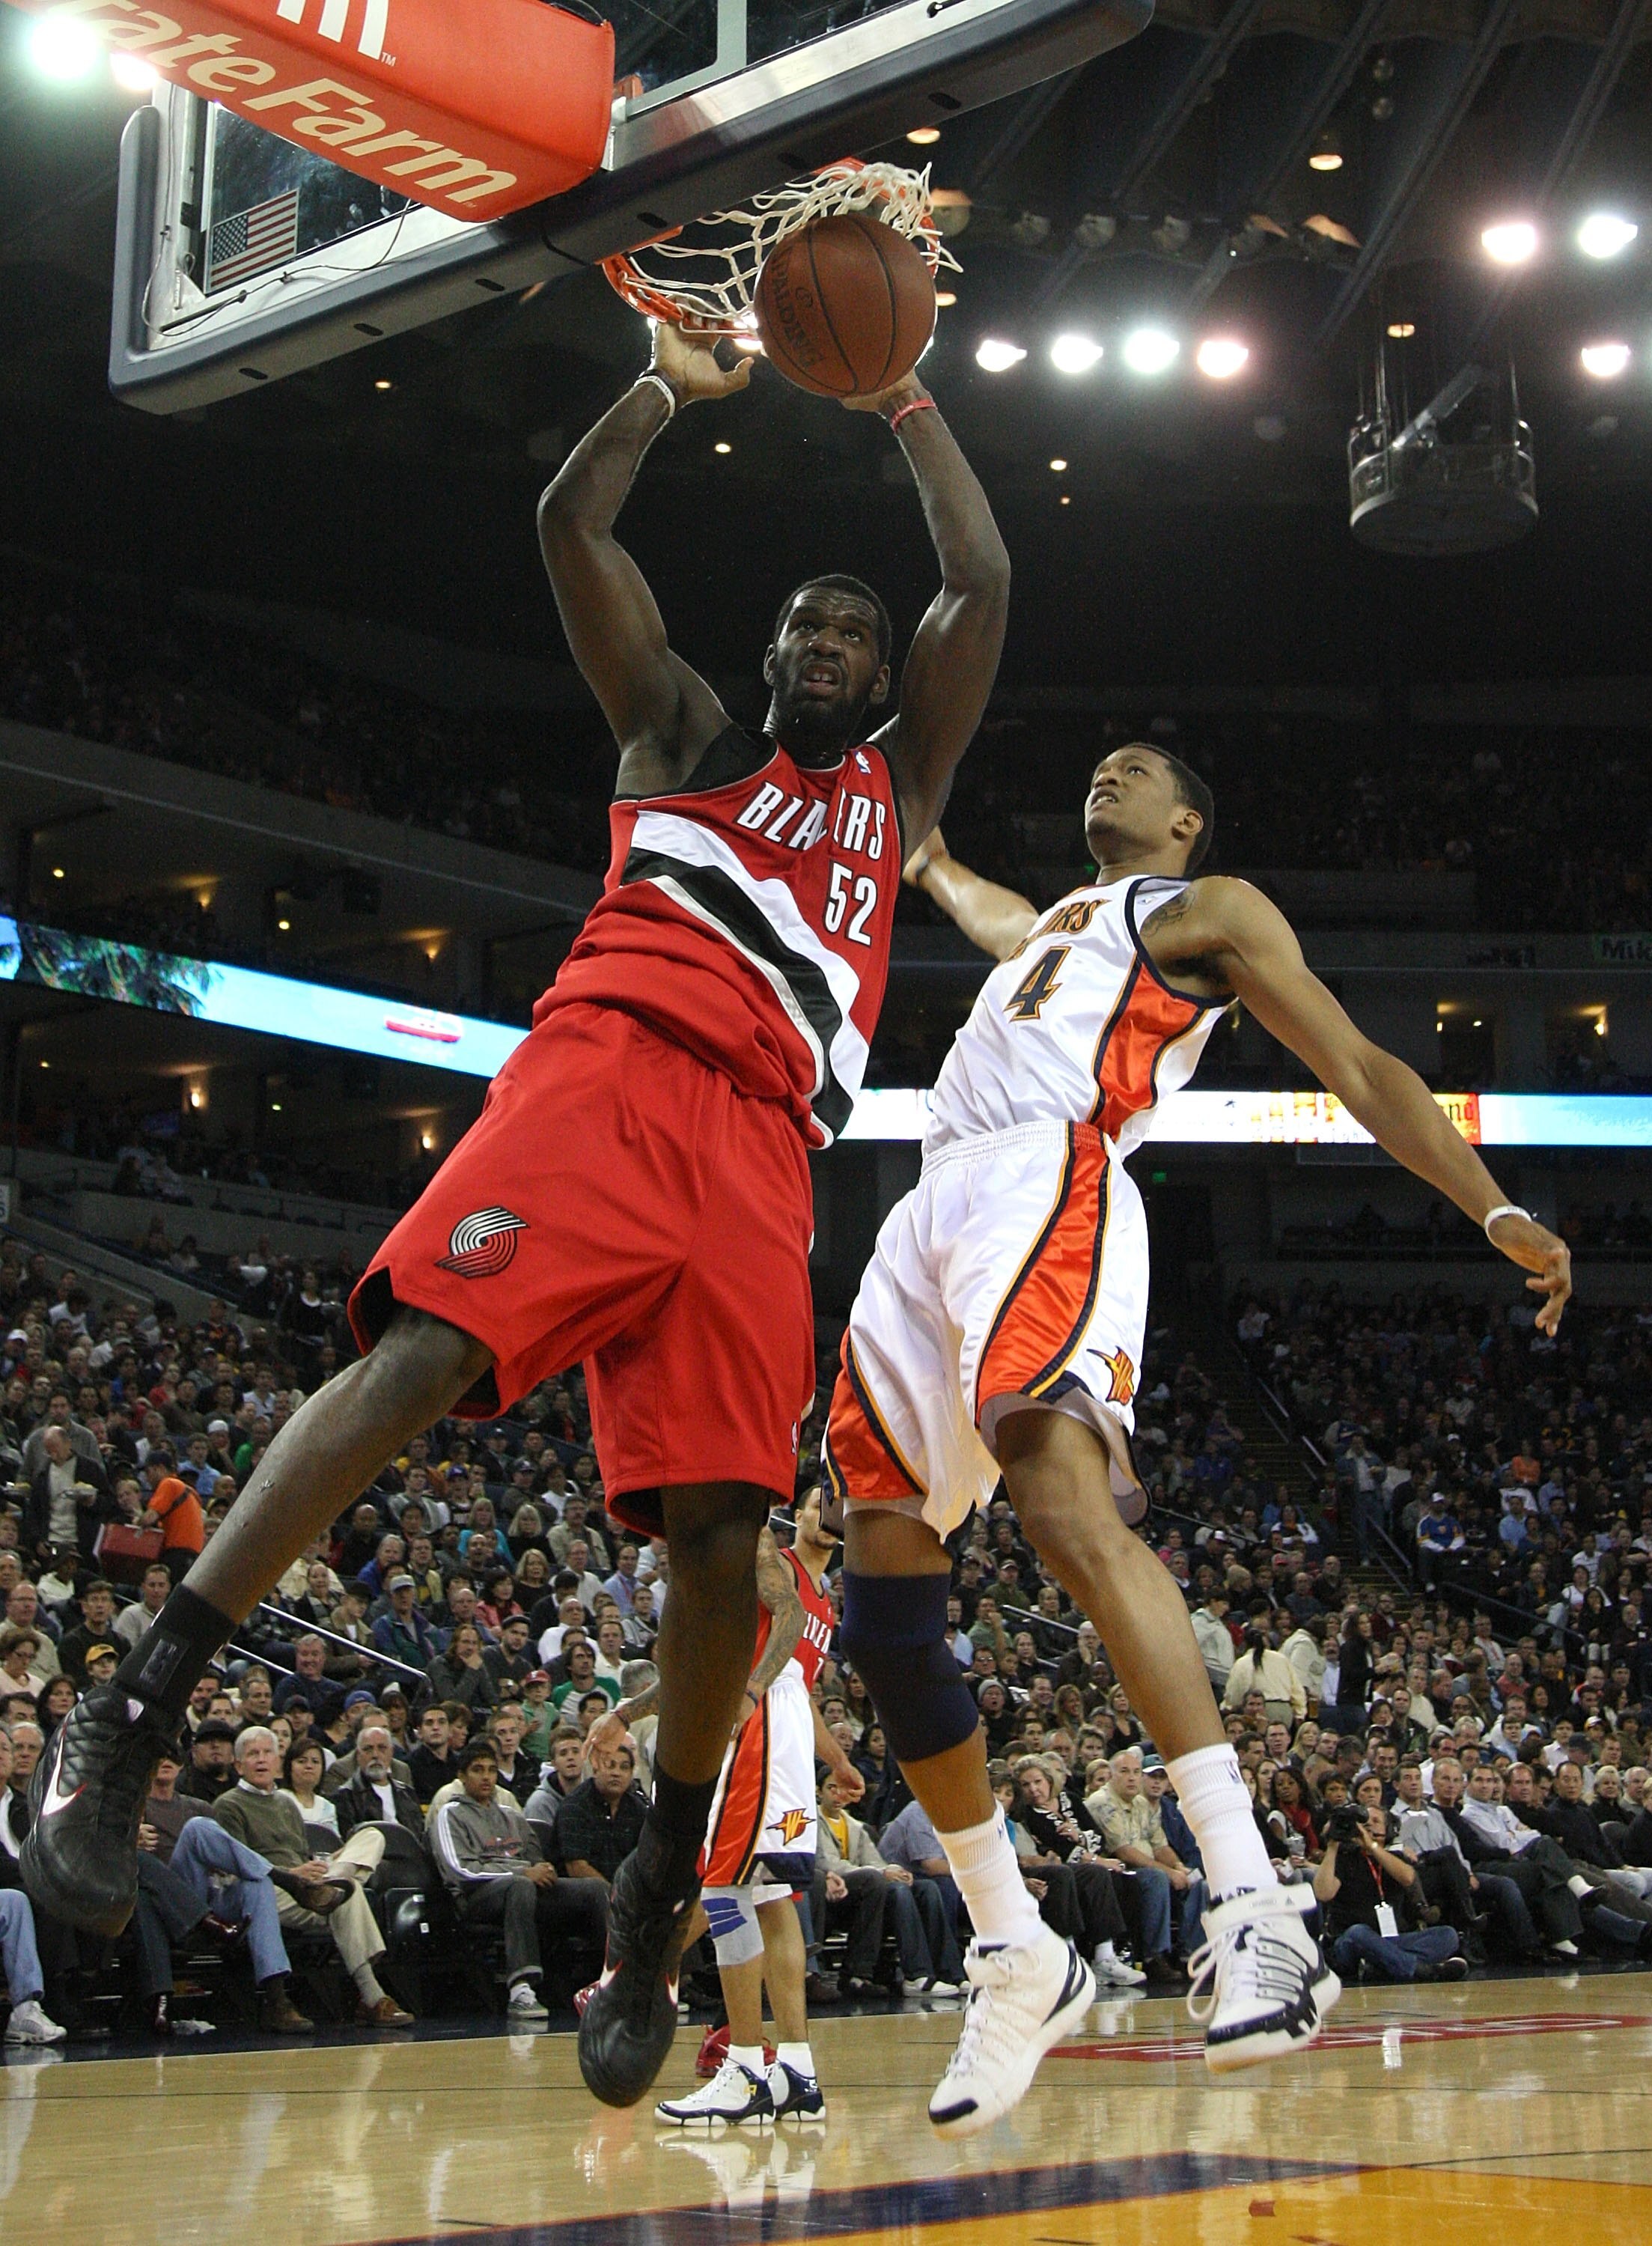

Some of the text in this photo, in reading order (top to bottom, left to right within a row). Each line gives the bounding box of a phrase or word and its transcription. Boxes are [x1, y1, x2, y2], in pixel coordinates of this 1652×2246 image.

[242, 78, 517, 203] Farm
[825, 862, 877, 946] 52
[1003, 945, 1071, 1023] 4
